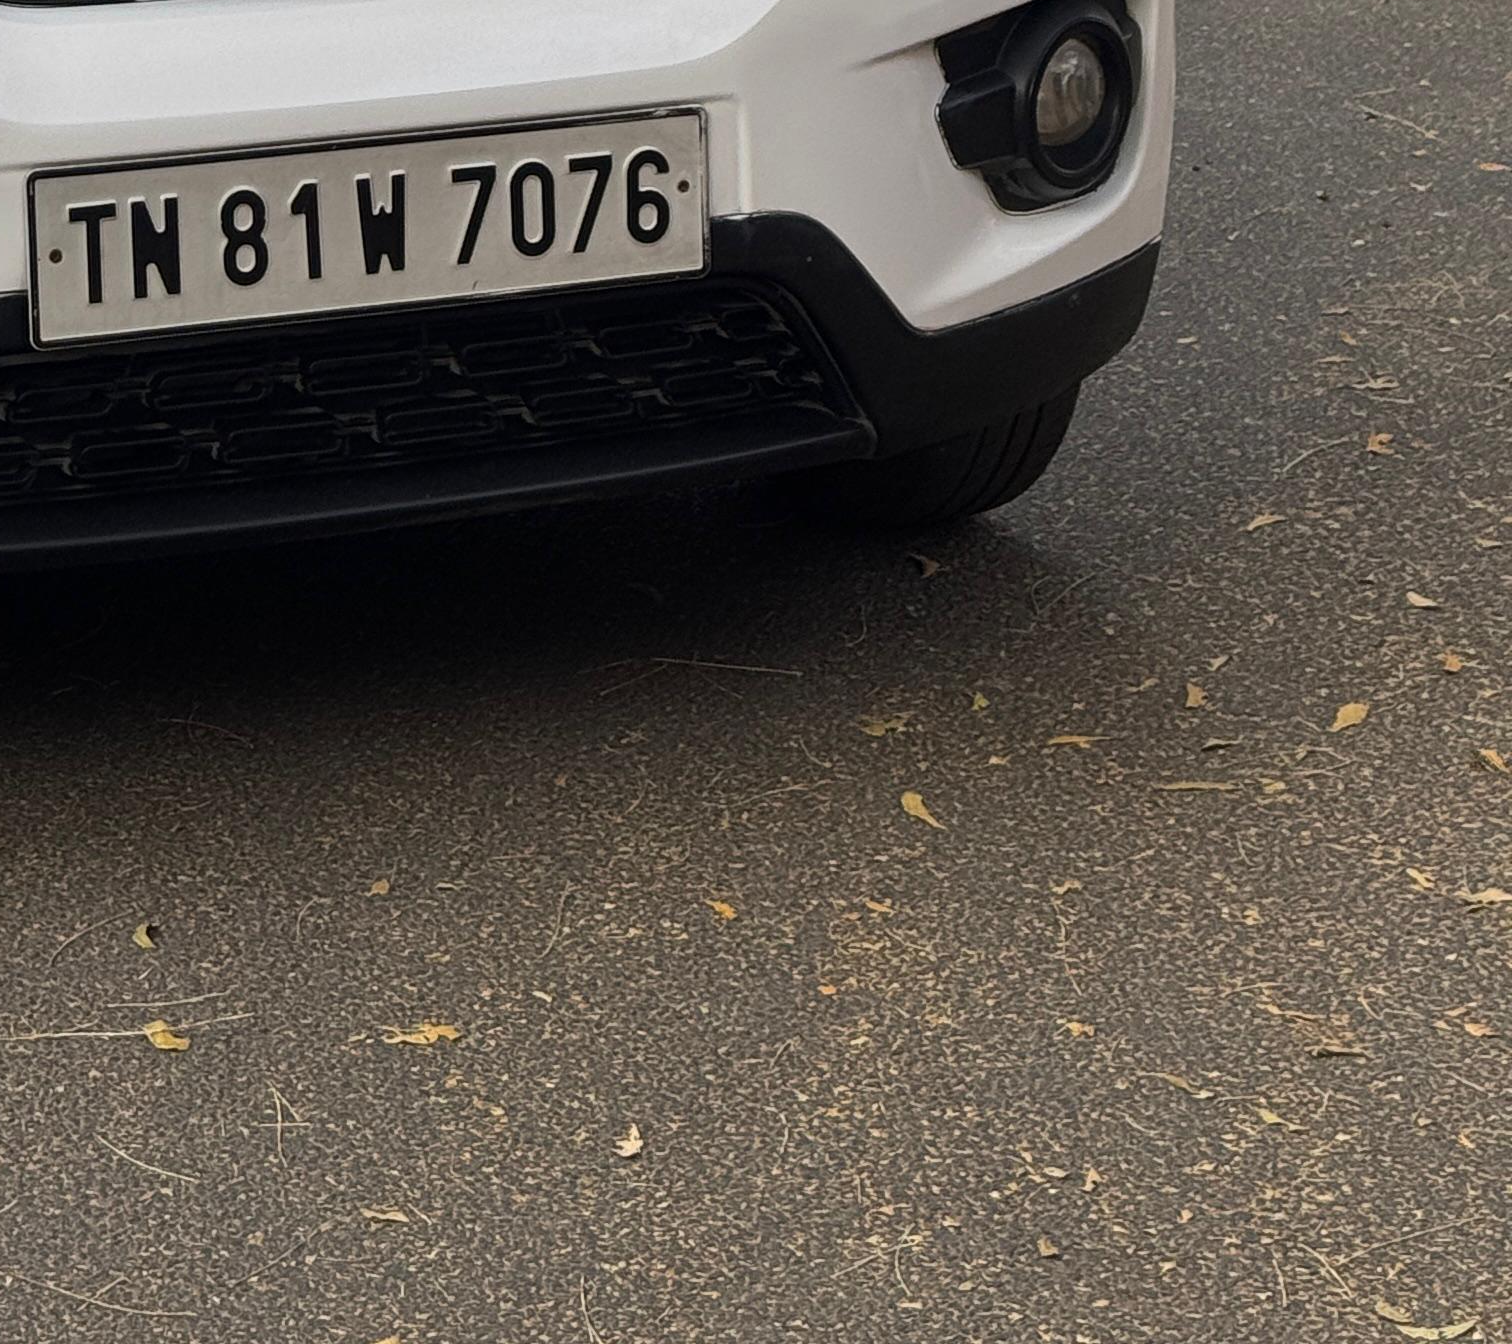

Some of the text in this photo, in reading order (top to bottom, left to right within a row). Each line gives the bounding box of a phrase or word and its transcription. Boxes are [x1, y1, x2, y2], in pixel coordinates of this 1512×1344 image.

[67, 148, 670, 305] TN 81 W 7076
